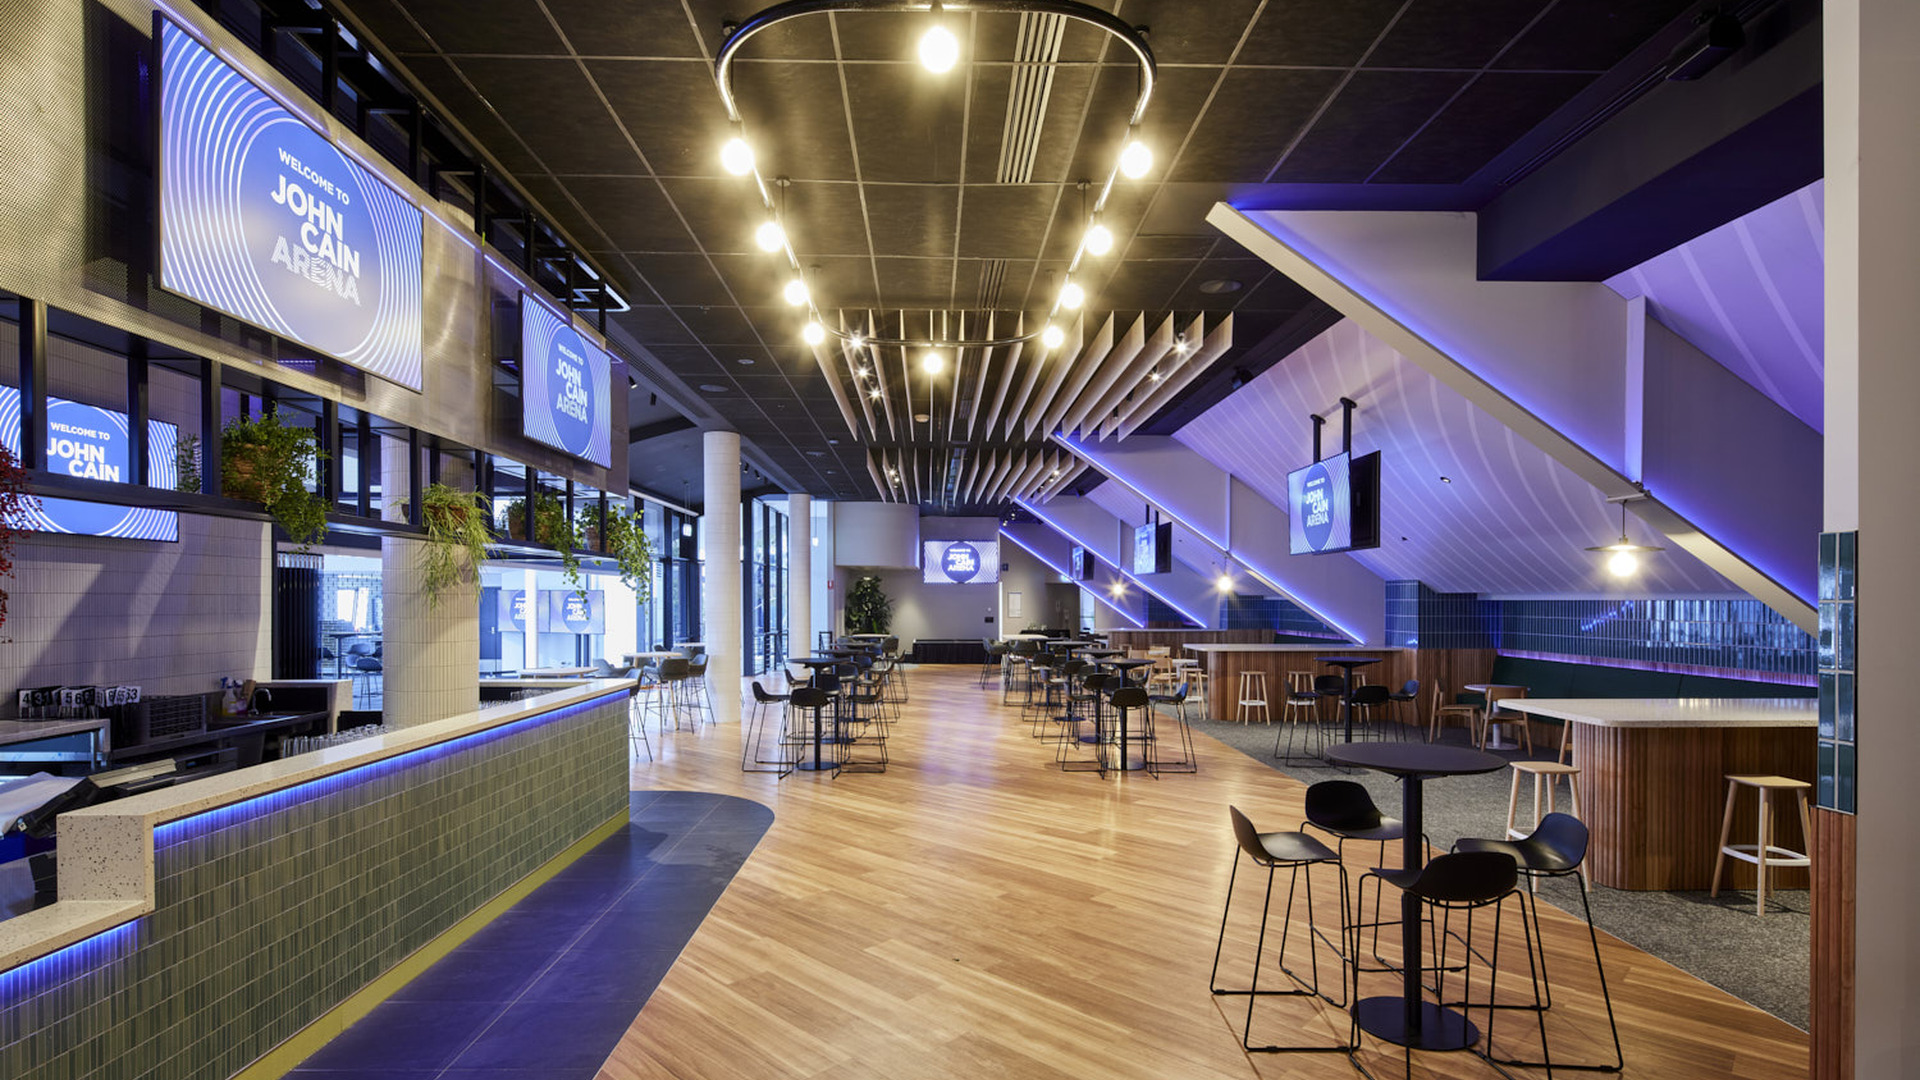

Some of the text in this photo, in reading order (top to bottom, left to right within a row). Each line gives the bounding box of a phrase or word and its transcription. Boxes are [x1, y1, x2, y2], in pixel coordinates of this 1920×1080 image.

[278, 147, 350, 206] WELCOME TO
[270, 174, 343, 241] JOHN
[300, 221, 360, 278] CAIN
[270, 235, 361, 307] ARENA
[556, 358, 582, 386] JOHN
[566, 381, 588, 407] CAIN
[556, 392, 588, 424] ARENA
[50, 422, 111, 441] WELCOME TO
[47, 437, 105, 464] JOHN
[68, 459, 120, 483] CAIN
[1305, 488, 1324, 505] JOHN
[1312, 498, 1329, 514] CAIN
[1306, 512, 1329, 528] ARENA
